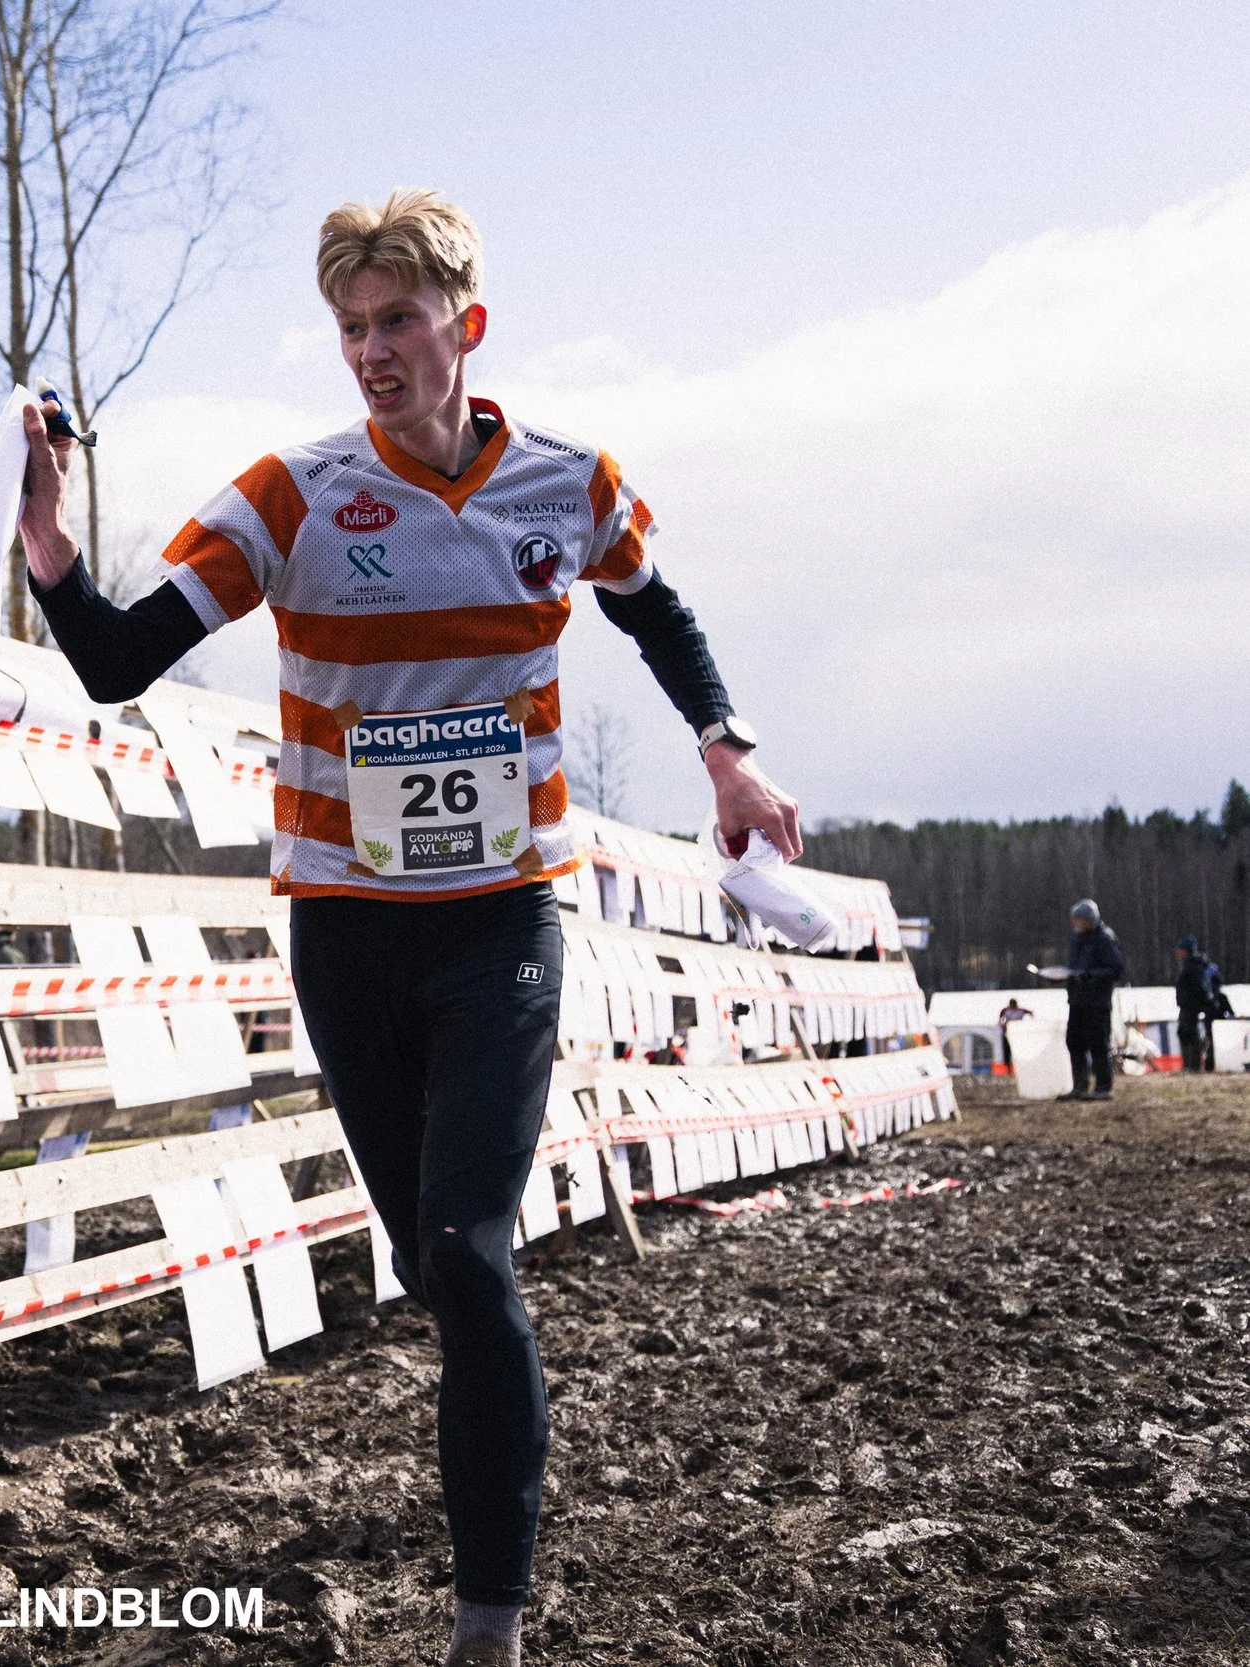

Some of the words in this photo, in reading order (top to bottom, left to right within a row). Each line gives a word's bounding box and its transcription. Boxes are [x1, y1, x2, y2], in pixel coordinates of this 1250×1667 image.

[524, 432, 587, 461] noname
[343, 507, 387, 526] Marli
[513, 503, 578, 515] NAANTALI
[351, 713, 518, 749] bagheera
[367, 751, 448, 764] KOLMÅRDSKAVLEN
[456, 748, 471, 757] STL
[472, 747, 483, 755] #1
[485, 744, 506, 754] 2026
[502, 761, 518, 780] 3
[400, 769, 478, 818] 26
[409, 830, 474, 843] GODKÄNDA
